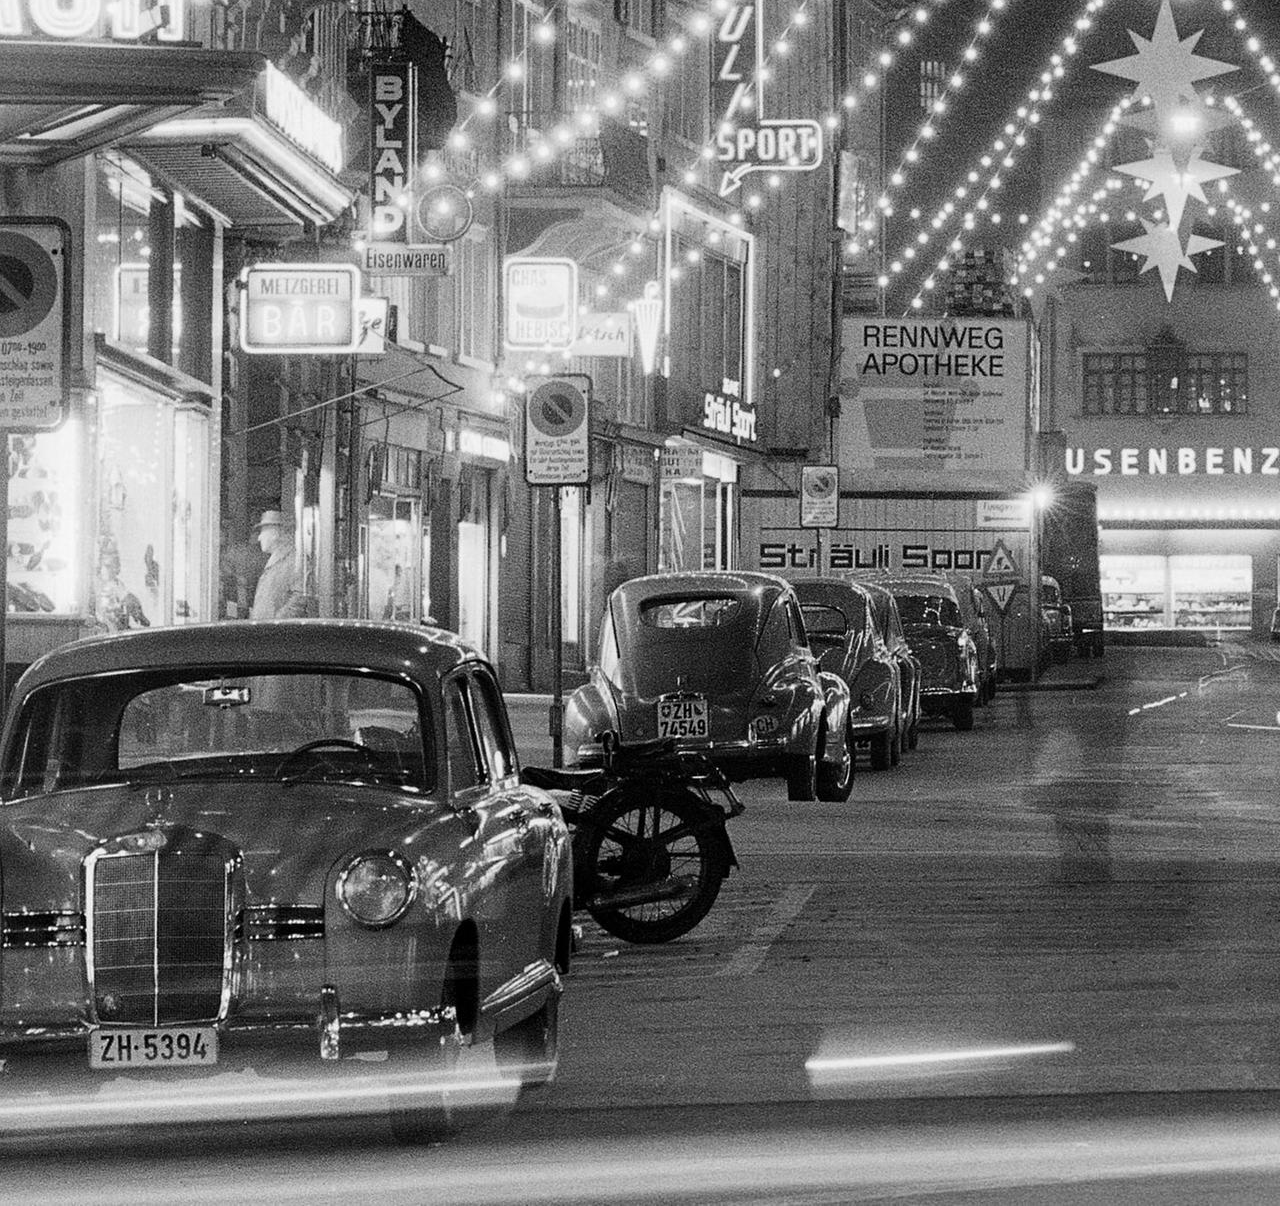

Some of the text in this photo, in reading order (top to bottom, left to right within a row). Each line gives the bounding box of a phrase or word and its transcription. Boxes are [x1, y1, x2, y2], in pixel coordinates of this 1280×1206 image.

[375, 76, 404, 232] BYLAND
[717, 127, 814, 162] SPORT
[366, 248, 446, 269] Eisenwaren
[261, 278, 339, 295] METZGEREI
[863, 325, 1003, 349] RENNWEG
[862, 353, 1003, 376] APOTHEKE
[760, 544, 1012, 570] Sträuli Spor
[673, 704, 692, 719] ZH
[660, 720, 706, 737] 74549
